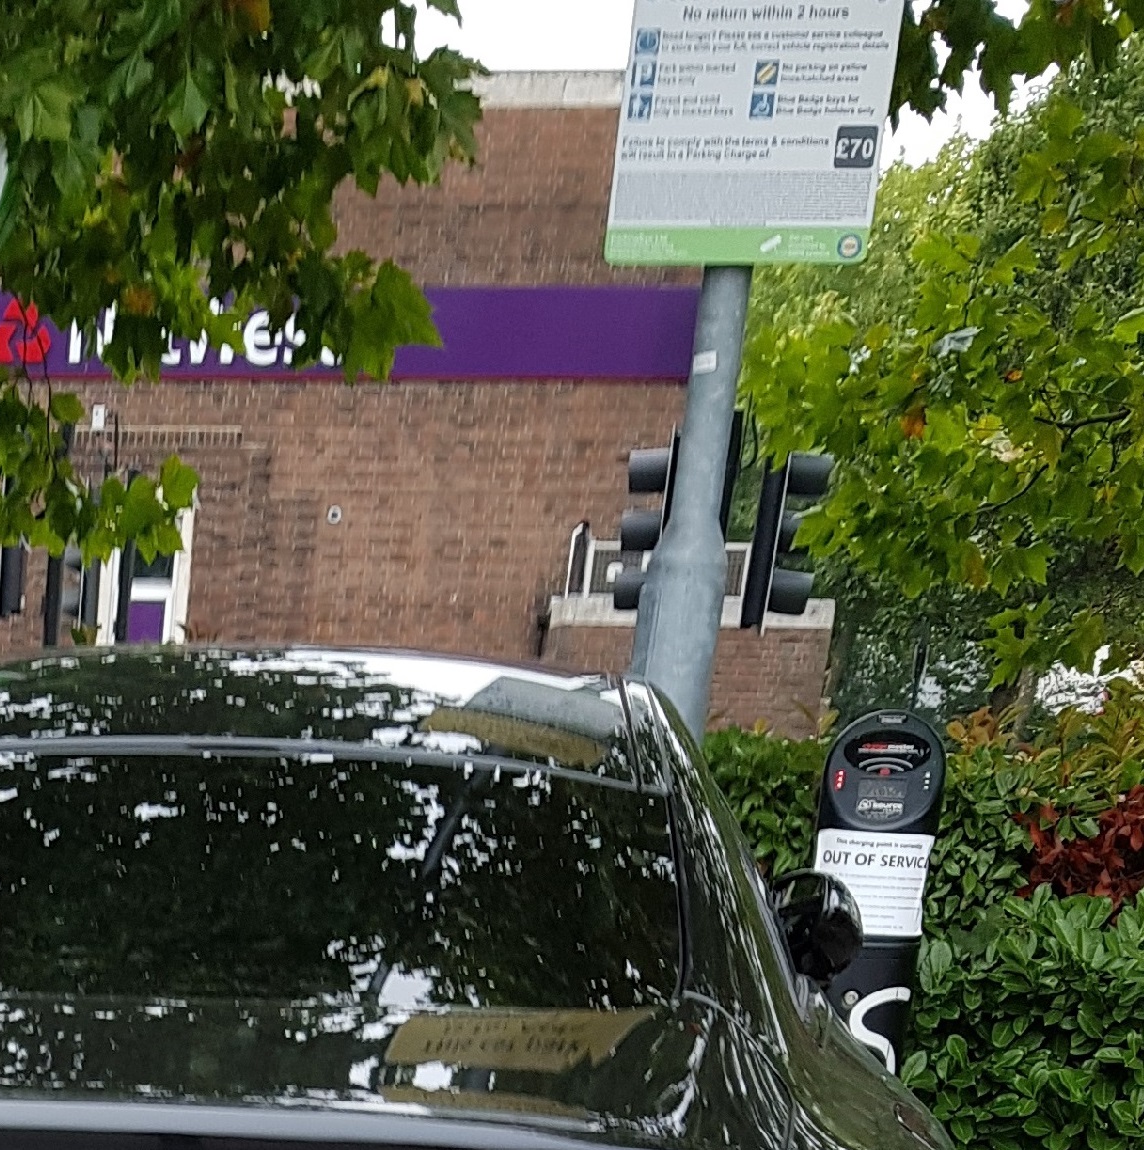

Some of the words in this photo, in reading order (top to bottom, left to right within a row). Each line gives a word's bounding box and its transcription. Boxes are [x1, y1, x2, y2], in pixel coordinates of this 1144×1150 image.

[682, 4, 702, 21] No
[706, 4, 747, 20] return
[752, 4, 793, 20] within
[797, 4, 806, 20] 2
[809, 4, 850, 20] hours
[836, 137, 876, 160] £70
[822, 849, 852, 866] OUT
[854, 852, 877, 867] OF
